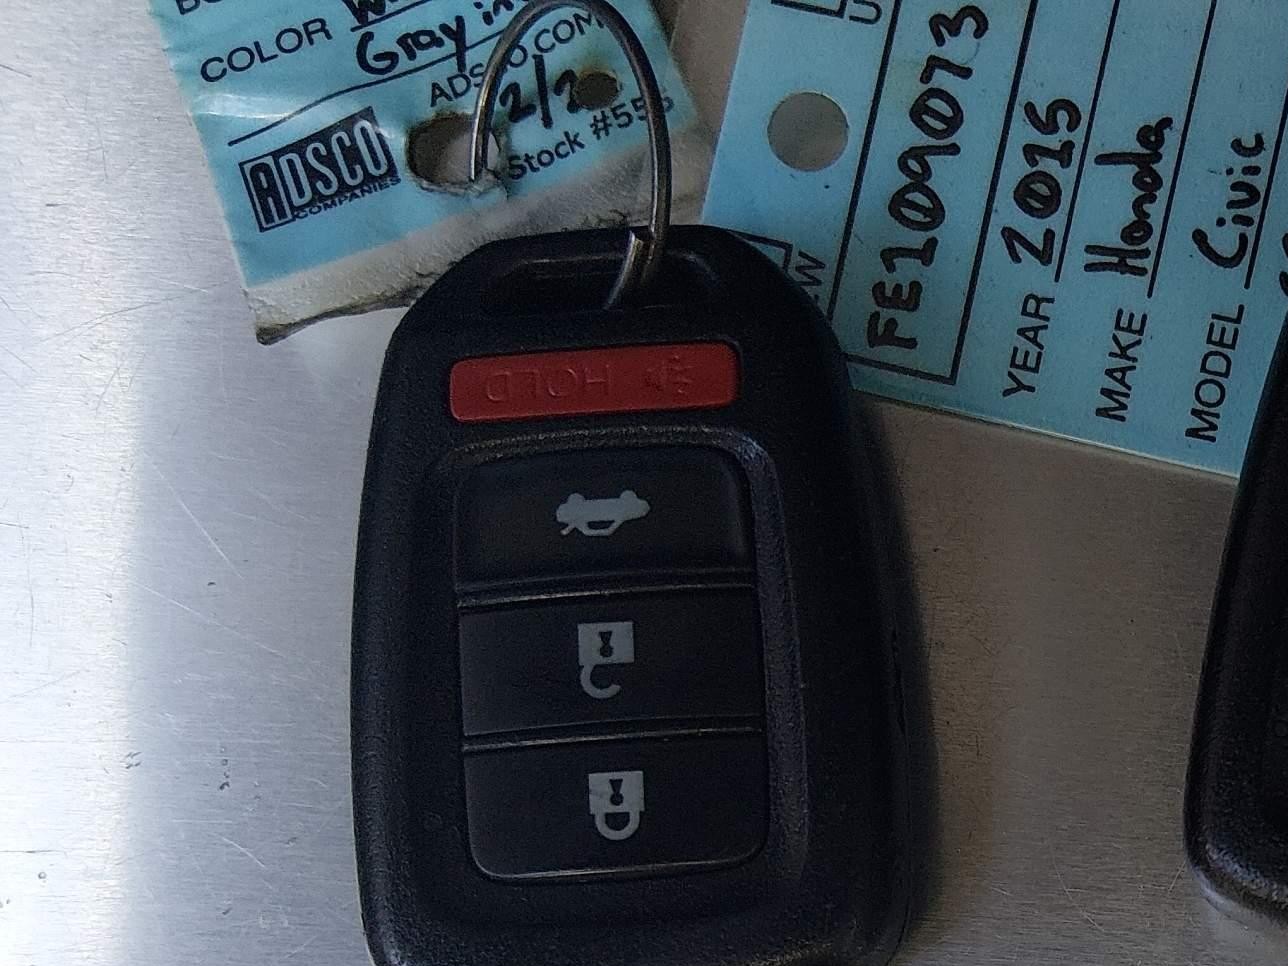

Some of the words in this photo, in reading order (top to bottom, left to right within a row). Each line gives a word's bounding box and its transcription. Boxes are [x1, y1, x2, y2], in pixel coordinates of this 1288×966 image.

[200, 17, 333, 83] COLOR
[356, 15, 467, 76] Gray
[243, 119, 390, 229] ADSCO
[294, 176, 402, 220] COMPANIES
[507, 130, 586, 180] Stock
[1000, 98, 1082, 267] 2015
[1084, 116, 1174, 278] Honda
[1192, 132, 1265, 270] Civic
[485, 362, 613, 403] HOLD
[1002, 293, 1056, 399] YEAR
[1095, 308, 1149, 423] MAKE
[1184, 304, 1247, 444] MODEL
